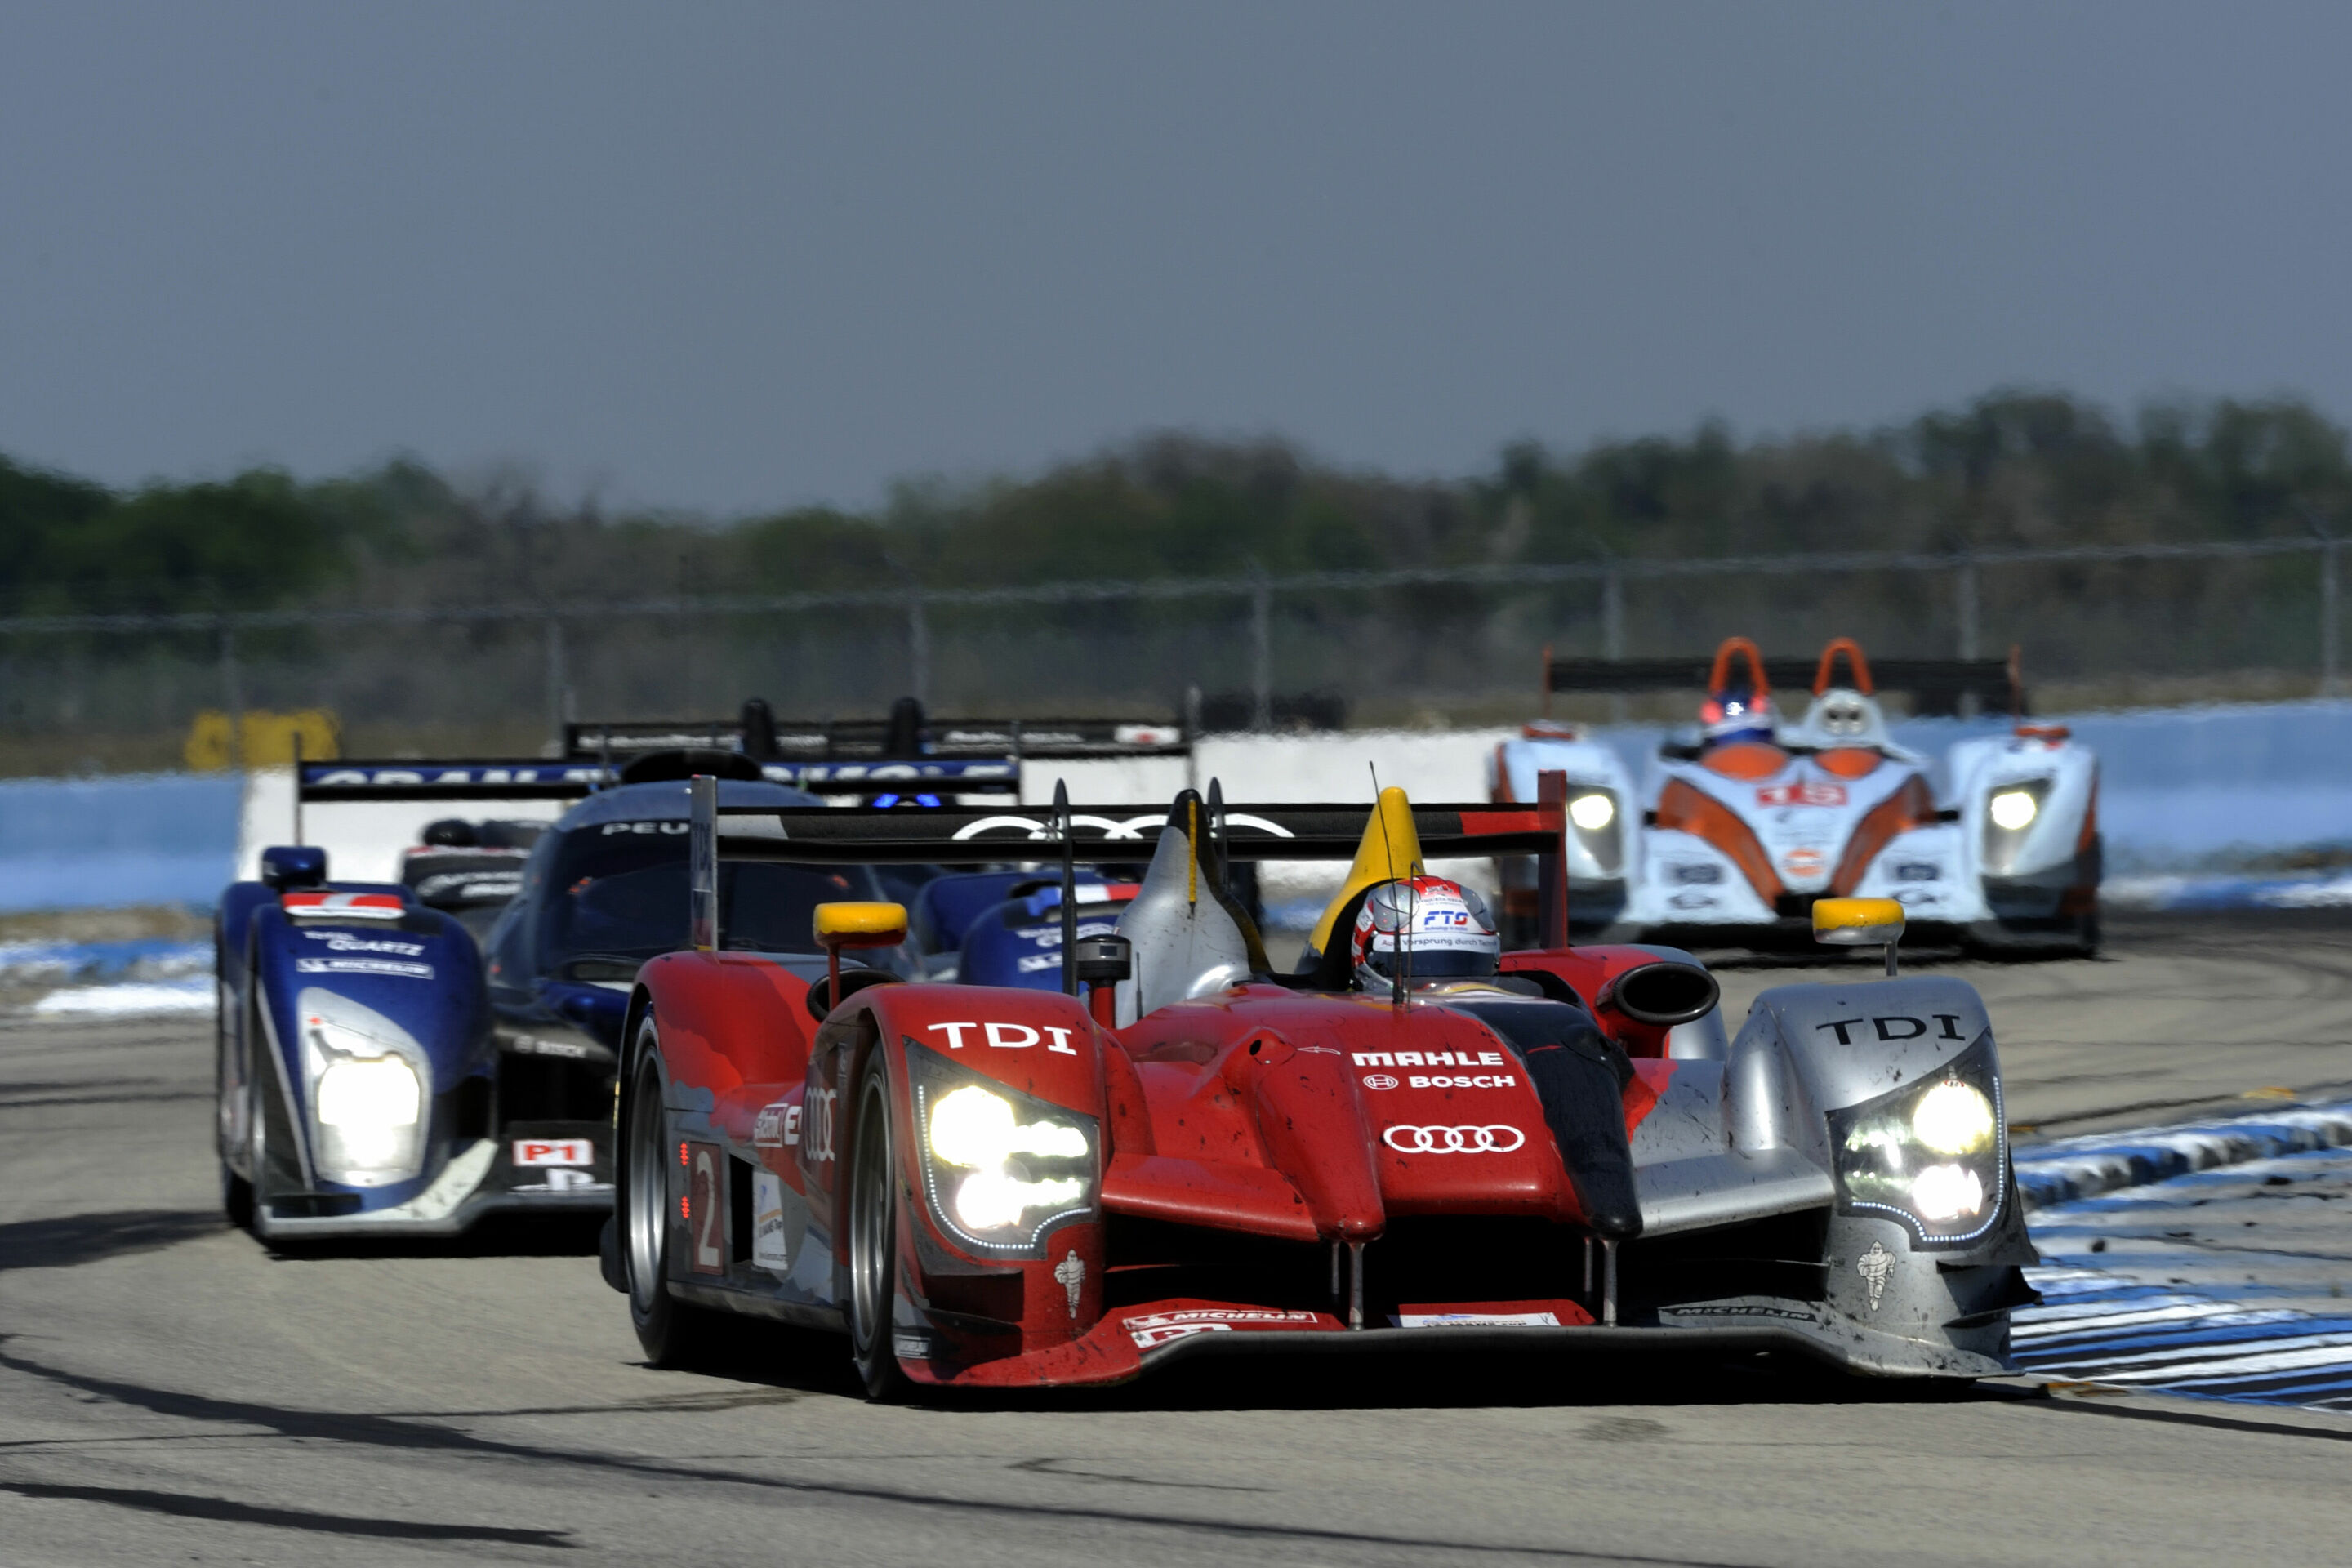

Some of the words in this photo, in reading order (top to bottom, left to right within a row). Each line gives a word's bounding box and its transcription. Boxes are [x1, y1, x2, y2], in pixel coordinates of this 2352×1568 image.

[1424, 911, 1468, 925] FTS
[1815, 1014, 1966, 1045] TDI
[927, 1022, 1077, 1056] TDI
[1351, 1051, 1504, 1067] MAHLE
[1408, 1075, 1517, 1089] BOSCH
[523, 1144, 577, 1161] P1
[697, 1150, 719, 1267] 2
[1173, 1312, 1307, 1321] MICHELIN
[1676, 1307, 1811, 1320] MICHELIN
